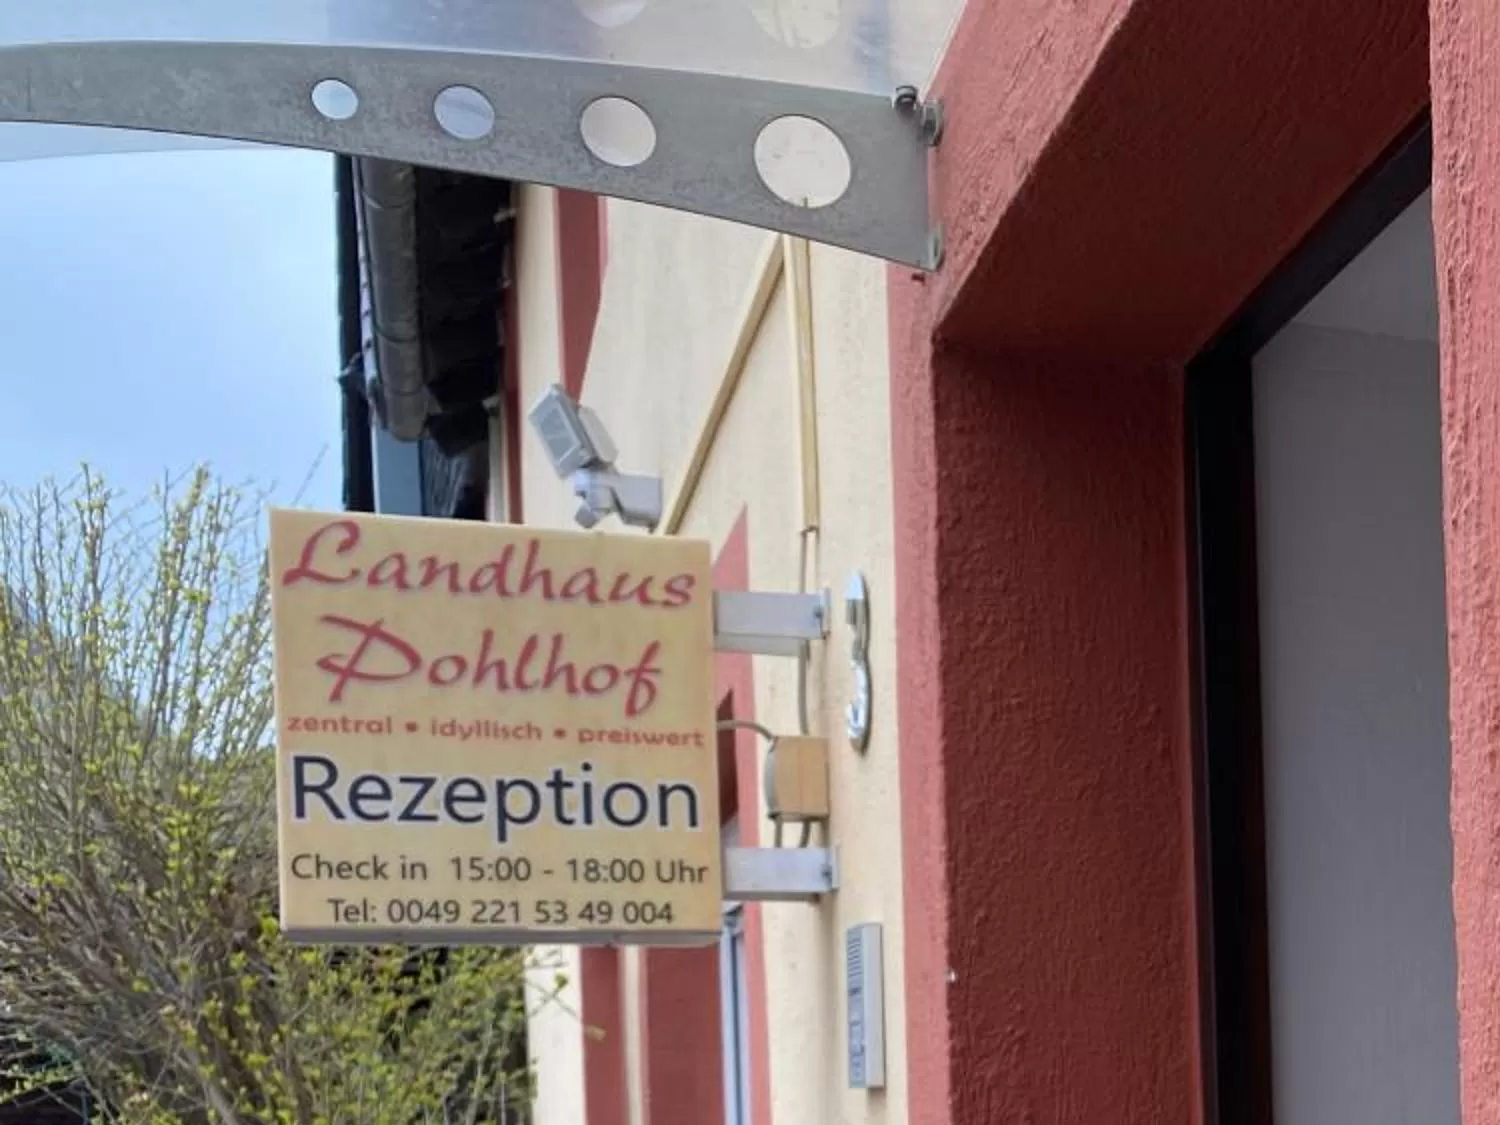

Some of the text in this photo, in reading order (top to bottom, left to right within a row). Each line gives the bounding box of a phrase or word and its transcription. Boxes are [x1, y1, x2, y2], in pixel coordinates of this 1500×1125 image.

[282, 519, 696, 609] Landhaus
[315, 613, 662, 719] Pohlhof
[287, 713, 706, 749] zentral idyllisch preiswert
[292, 755, 699, 843] Rezeption
[290, 853, 388, 882] Check
[401, 855, 428, 882] in
[450, 857, 532, 883] 15:00
[566, 859, 645, 884] 18:00
[655, 862, 710, 884] Uhr
[328, 898, 674, 924] Tel: 0049 221 53 49 004
